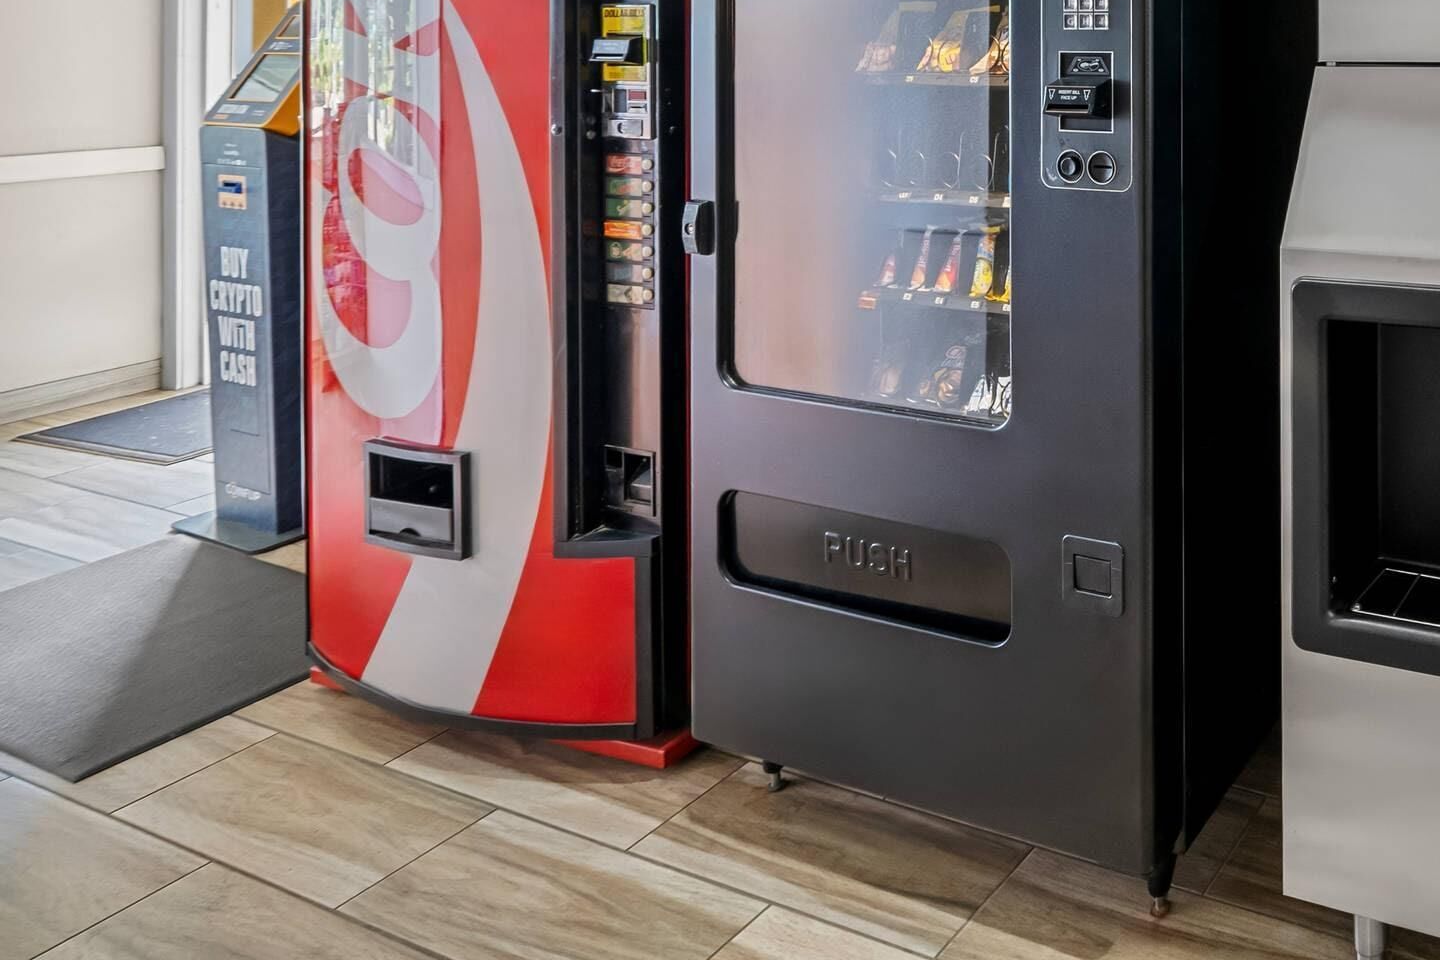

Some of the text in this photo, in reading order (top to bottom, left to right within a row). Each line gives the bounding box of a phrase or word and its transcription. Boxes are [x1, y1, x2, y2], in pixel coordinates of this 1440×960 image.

[220, 246, 249, 280] BUY
[210, 279, 262, 317] CRYPTO
[218, 316, 256, 352] WITH
[220, 350, 256, 387] CASH
[824, 532, 912, 581] PUSH
